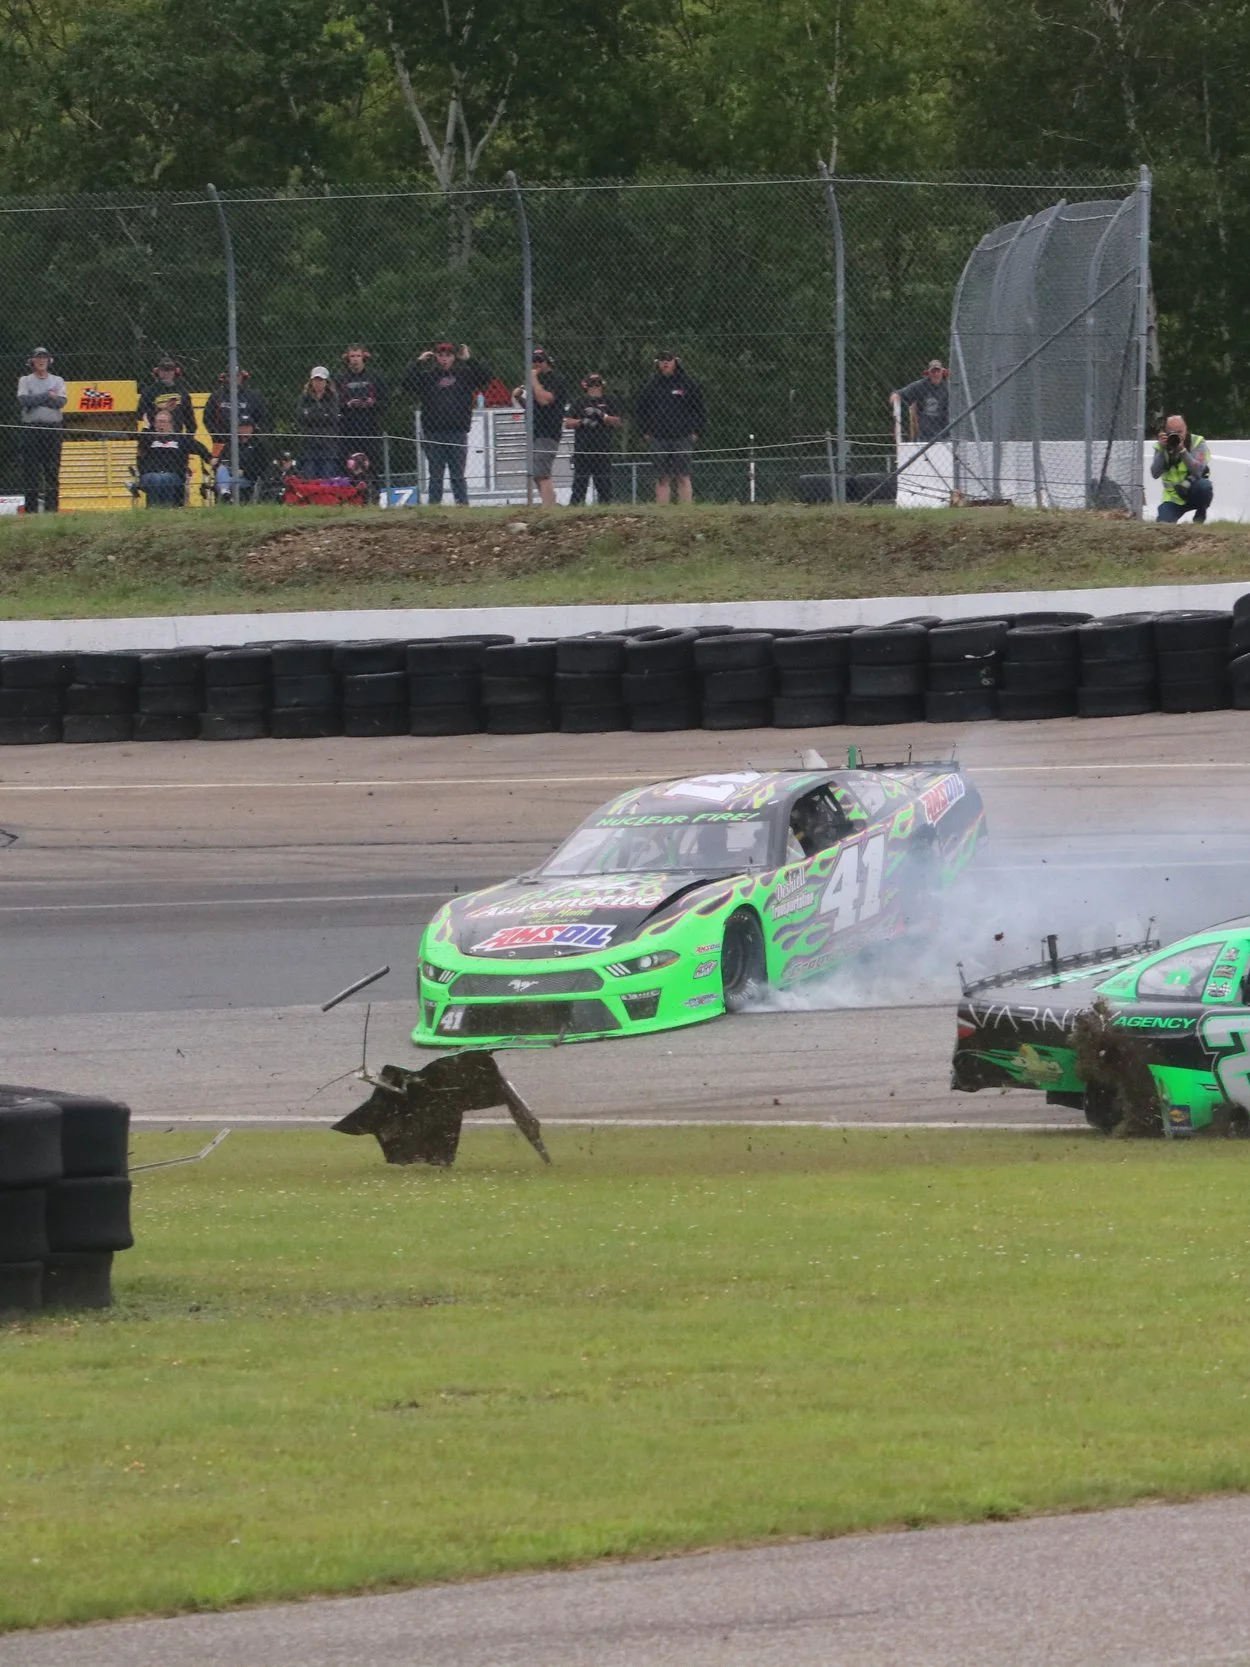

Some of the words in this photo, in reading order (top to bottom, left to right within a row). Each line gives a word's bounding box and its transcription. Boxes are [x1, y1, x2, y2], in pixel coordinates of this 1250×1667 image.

[596, 815, 689, 826] NUCLEAR
[692, 812, 761, 823] FIRE!
[820, 833, 885, 933] 41
[468, 896, 662, 918] Automotive
[478, 924, 617, 950] AMSOIL
[440, 1011, 464, 1030] 41
[1112, 1015, 1197, 1029] AGENCY
